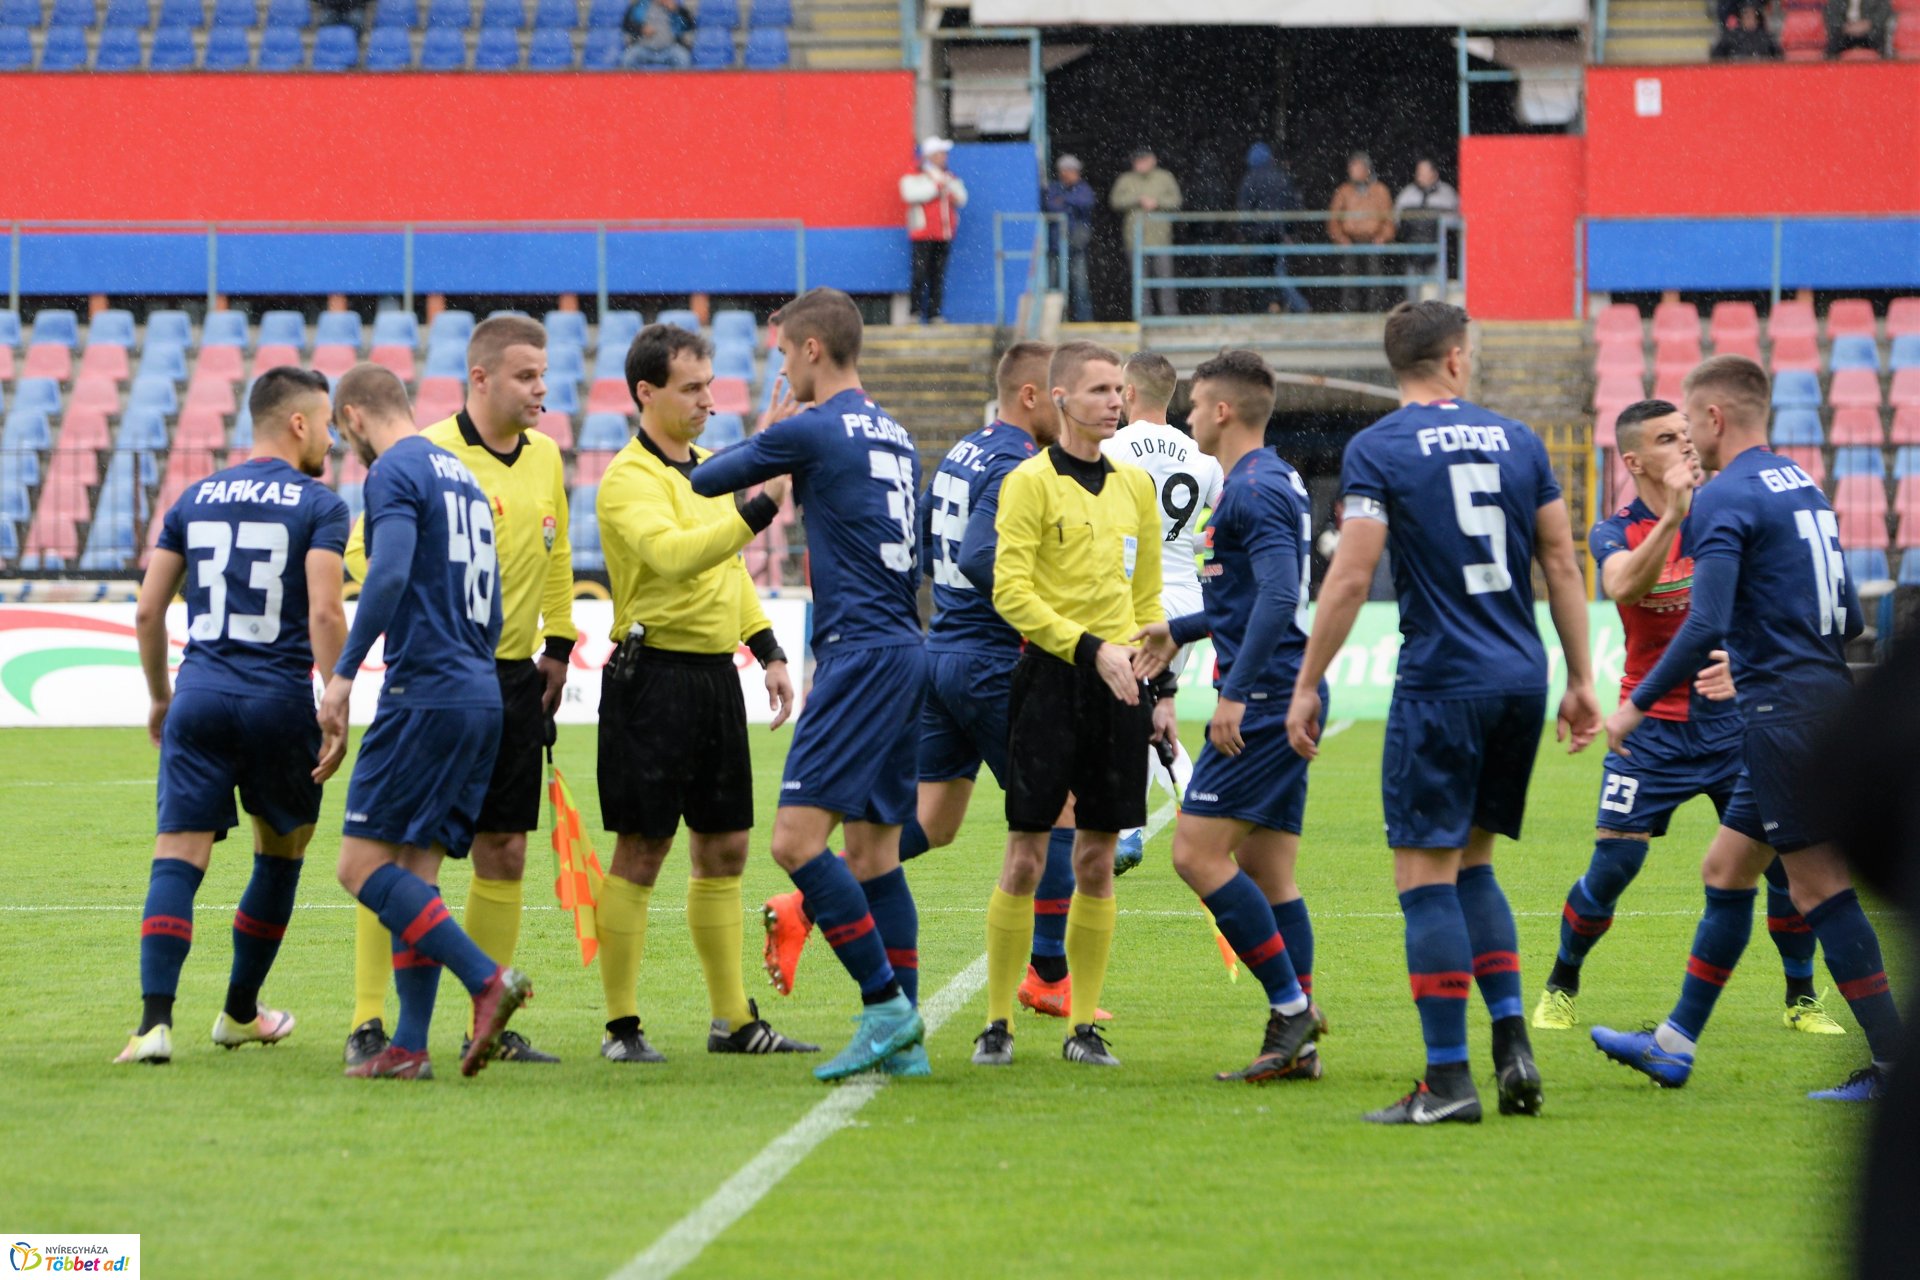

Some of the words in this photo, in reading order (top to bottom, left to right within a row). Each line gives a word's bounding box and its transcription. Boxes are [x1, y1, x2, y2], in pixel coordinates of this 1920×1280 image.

[1130, 438, 1188, 463] DOROG
[1416, 424, 1510, 456] FODOR
[194, 480, 303, 506] FARKAS
[1147, 471, 1200, 542] 9
[1448, 463, 1512, 595] 5
[187, 521, 289, 644] 33
[443, 491, 497, 627] 48
[1600, 773, 1639, 814] 23
